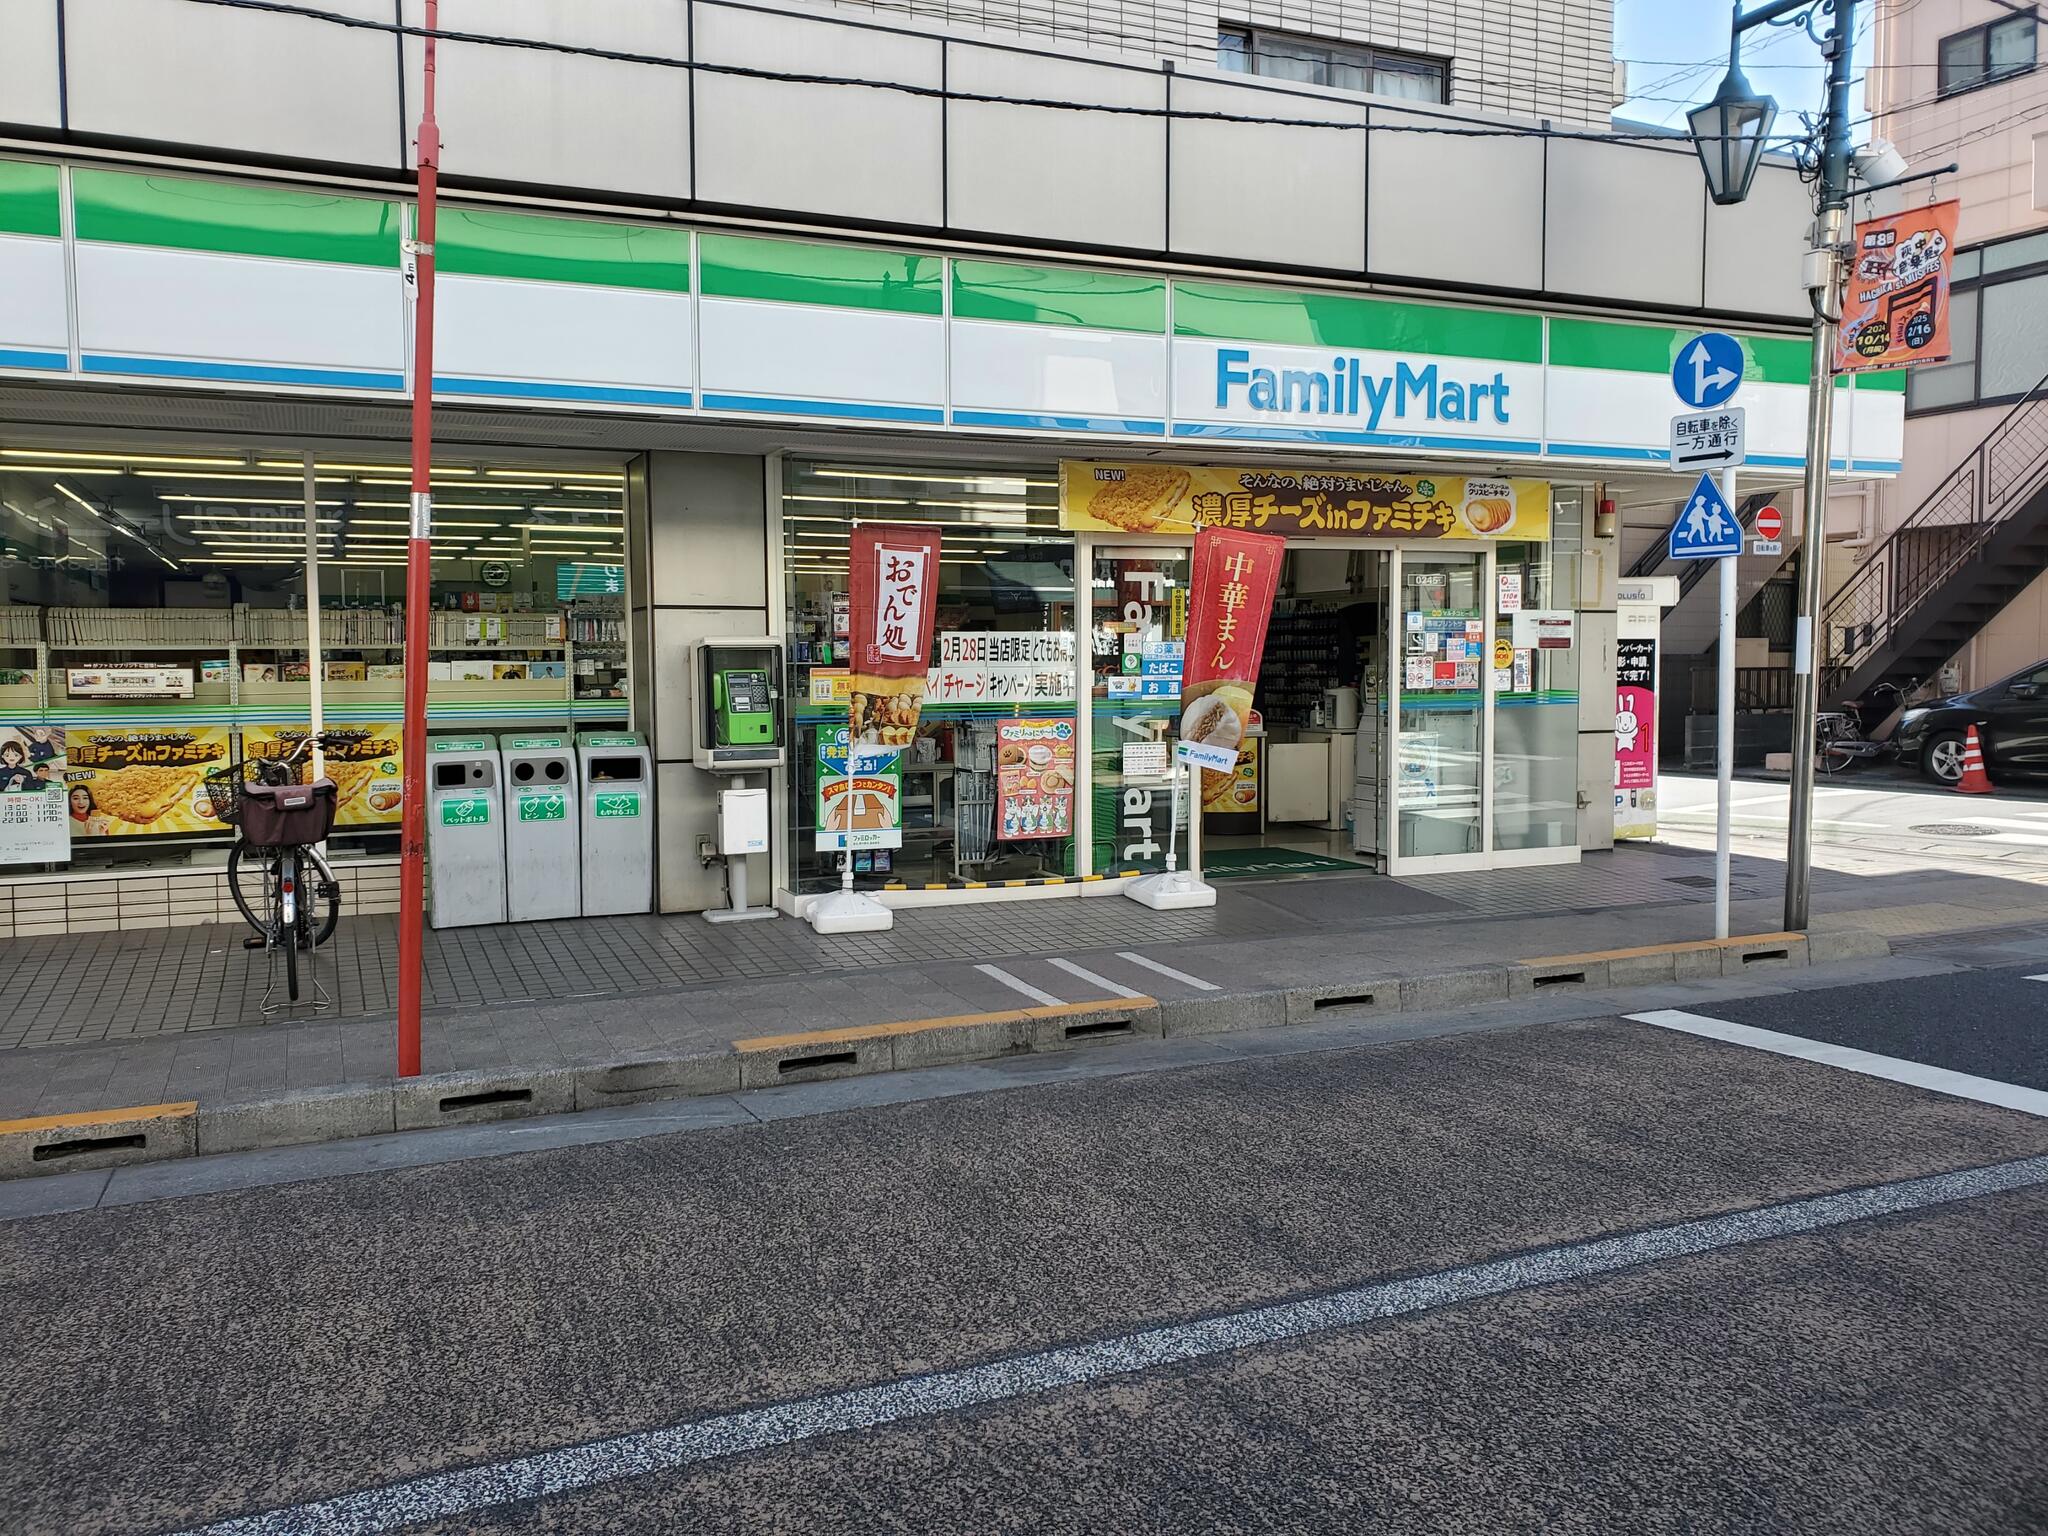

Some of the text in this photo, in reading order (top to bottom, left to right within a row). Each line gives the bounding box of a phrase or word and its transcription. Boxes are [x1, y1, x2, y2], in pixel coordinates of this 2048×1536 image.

[405, 262, 415, 285] 4m
[1866, 324, 1886, 334] 2024
[1907, 324, 1932, 337] 2/16
[1857, 333, 1890, 345] 10/14
[1911, 337, 1924, 346] (日)
[1215, 348, 1511, 432] FamilyMart
[1676, 415, 1738, 436] 自転車を除く
[1676, 431, 1739, 450] 一方通行
[1094, 468, 1126, 482] NEW!
[1238, 472, 1415, 496] そんなの、絶対うまいじゃん。
[1468, 489, 1510, 497] クリスピーチキン
[1191, 492, 1457, 534] 濃厚チーズinファミチキ
[881, 555, 918, 651] おでん処
[1210, 551, 1255, 670] 中華まん
[1148, 662, 1179, 674] たばこ
[88, 733, 197, 743] そんなの、絶対うまいじゃん。
[274, 729, 374, 739] そんなの、うまいじゃん。
[1189, 750, 1228, 765] FamilyMart
[67, 770, 96, 781] NEW!
[445, 815, 486, 823] ペットボトル
